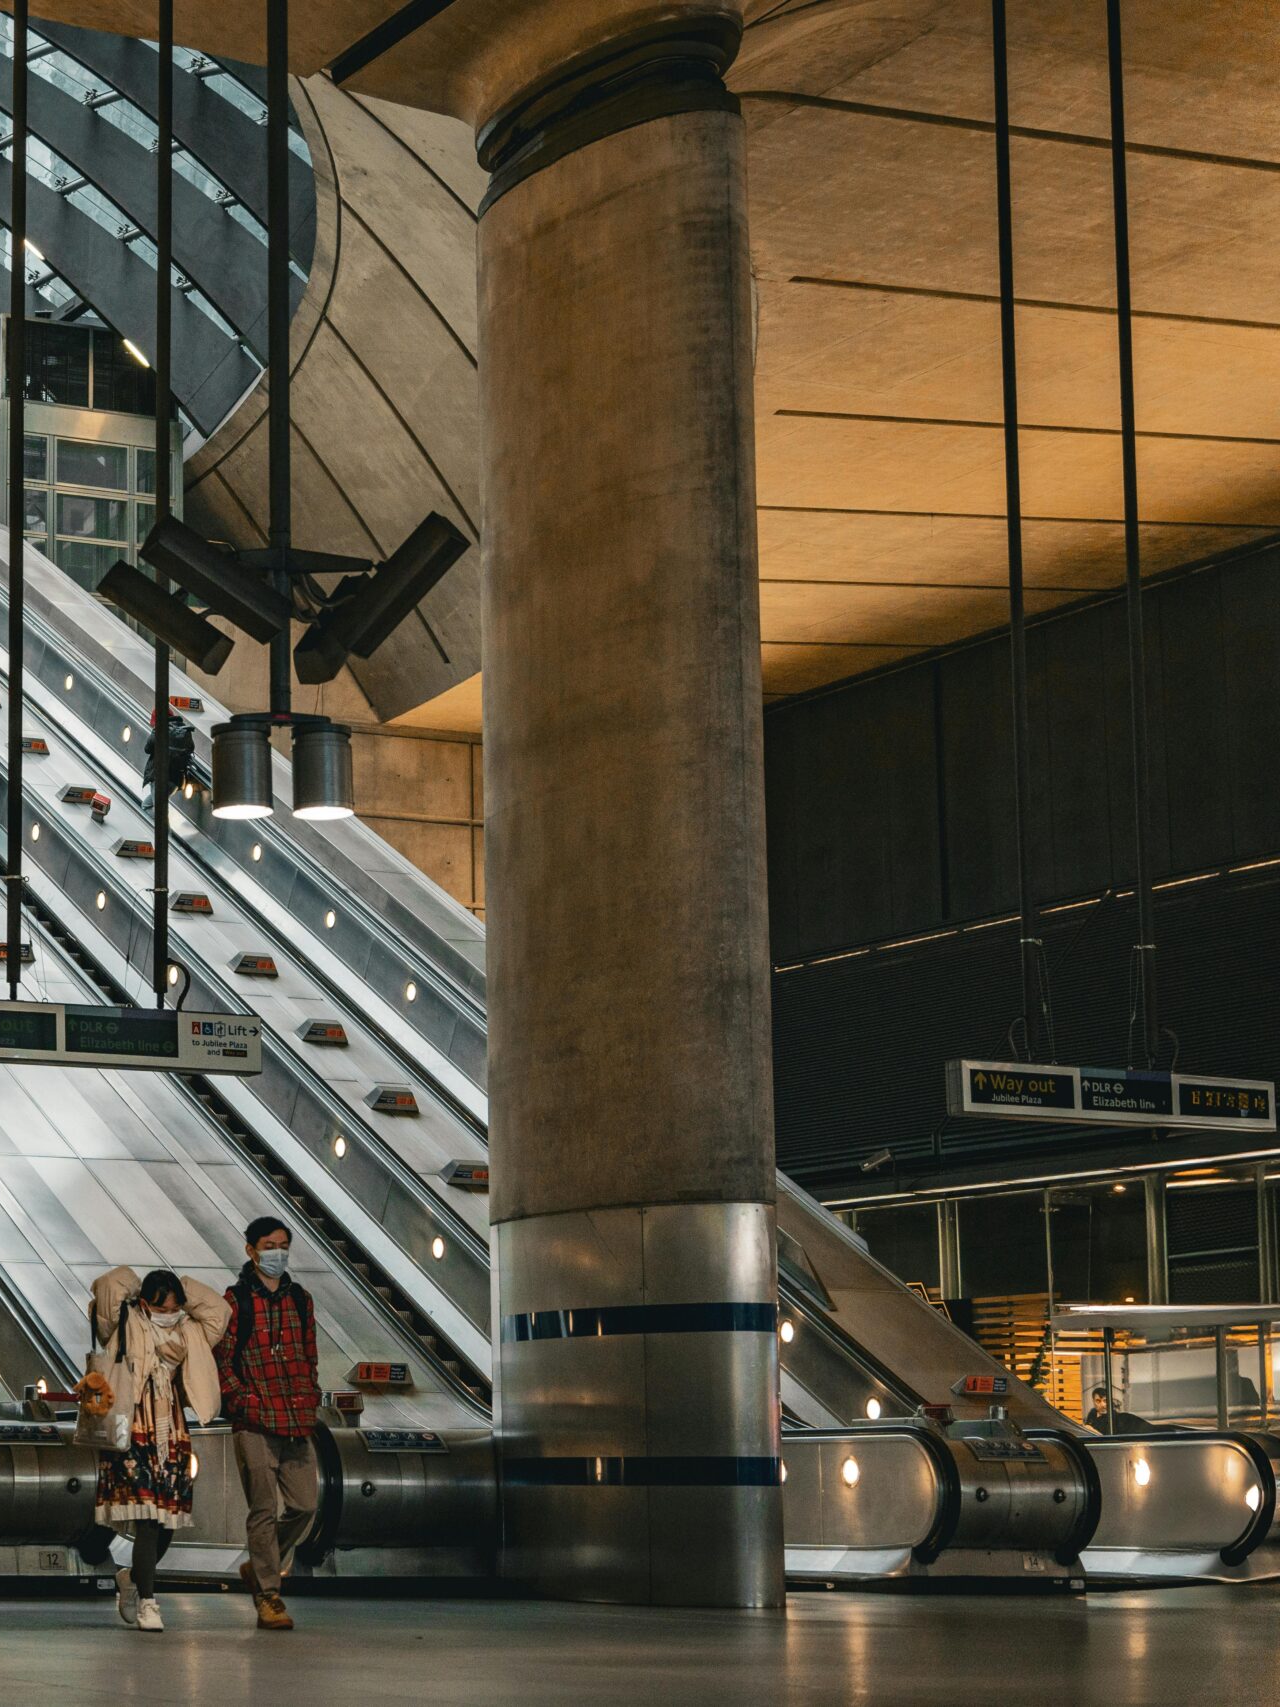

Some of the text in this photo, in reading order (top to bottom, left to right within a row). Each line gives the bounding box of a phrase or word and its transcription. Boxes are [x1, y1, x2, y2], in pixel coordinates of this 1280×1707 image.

[0, 1017, 34, 1033] out
[80, 1020, 103, 1033] DLR
[228, 1025, 248, 1036] Lift
[80, 1036, 160, 1052] Elizabeth line
[202, 1039, 227, 1048] Jubilee
[229, 1041, 248, 1049] Plaza
[990, 1073, 1057, 1095] Way out
[1092, 1082, 1111, 1093] DLR
[991, 1092, 1042, 1104] Jubilee Plaza
[1092, 1095, 1137, 1109] Elizabeth
[46, 1553, 59, 1566] 12
[1028, 1557, 1039, 1567] 14
